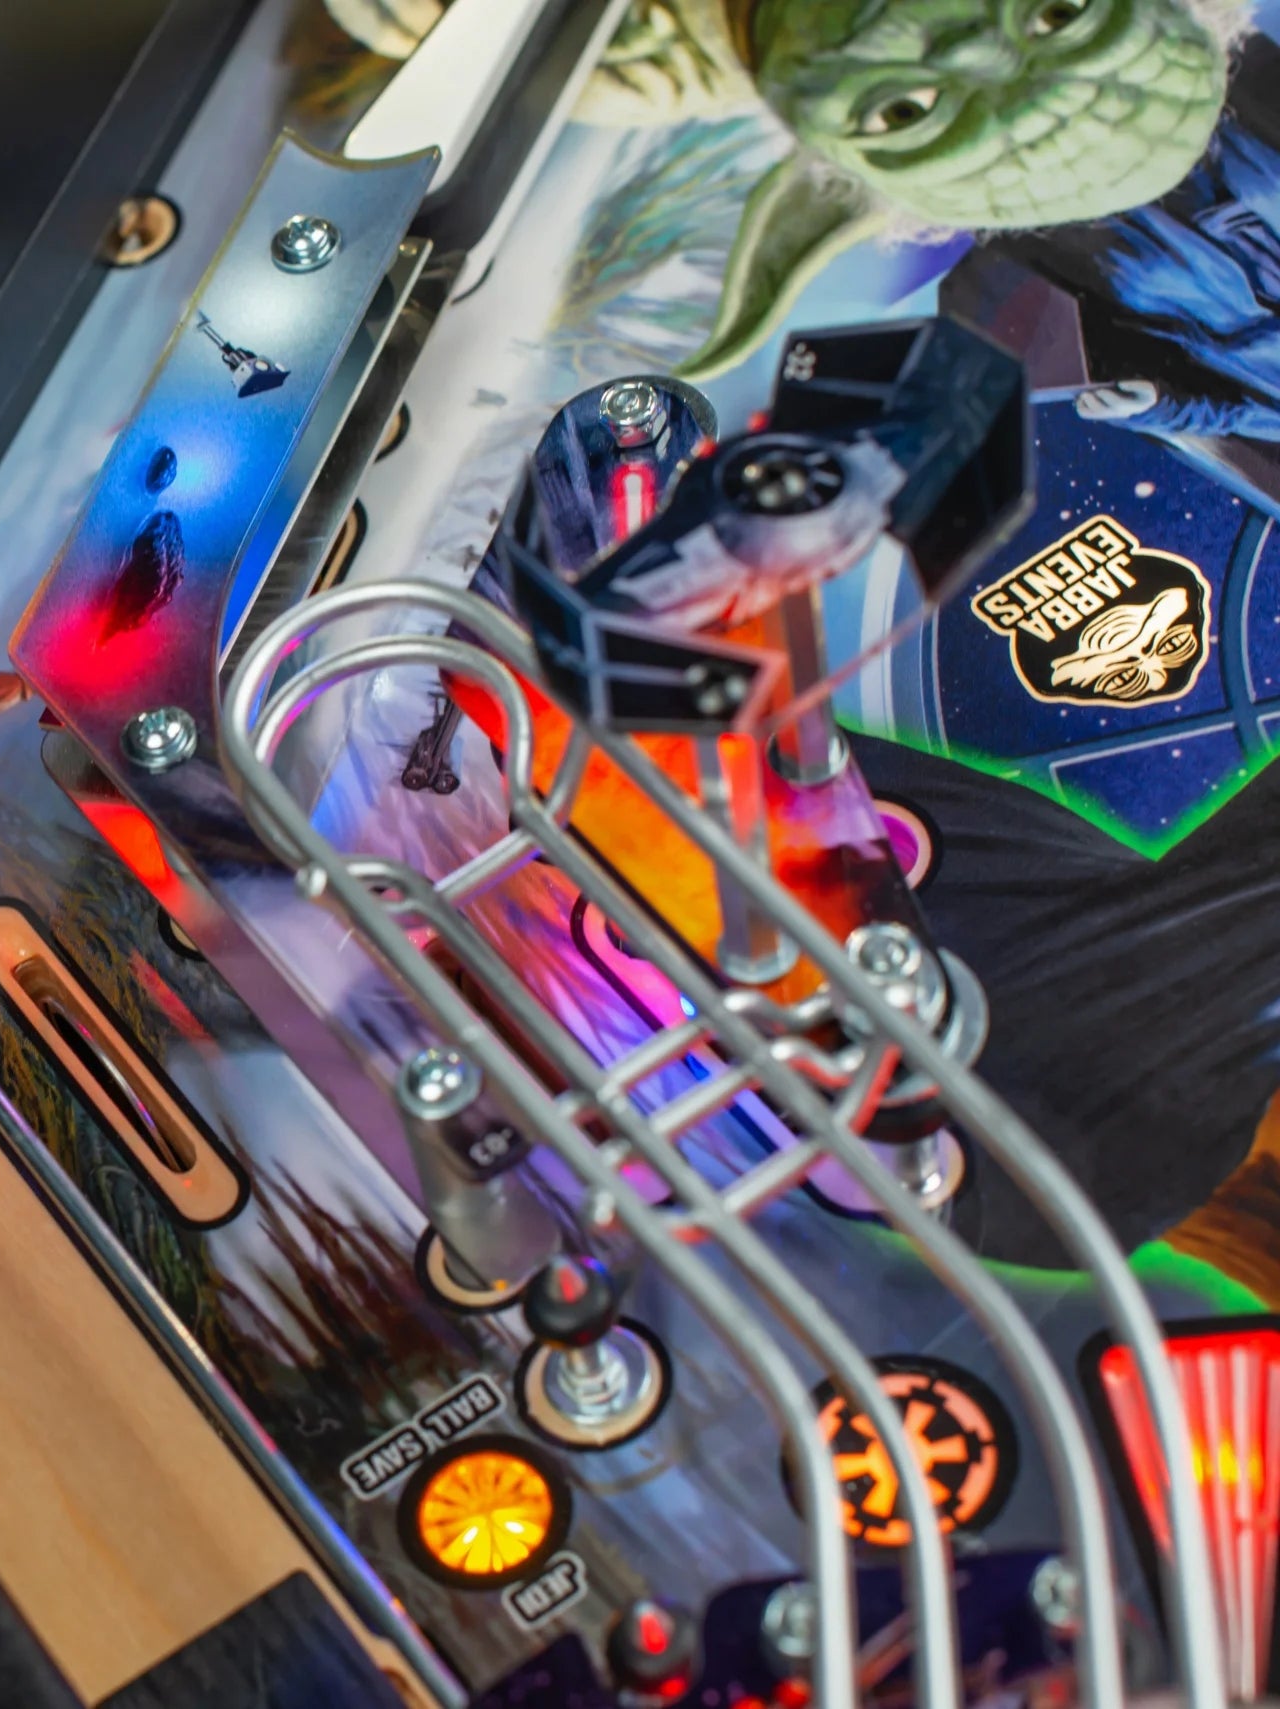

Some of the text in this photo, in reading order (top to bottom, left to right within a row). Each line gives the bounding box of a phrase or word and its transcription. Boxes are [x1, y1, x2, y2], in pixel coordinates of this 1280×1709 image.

[984, 524, 1126, 627] EVENTS
[1017, 553, 1137, 643] JABBA
[352, 1384, 493, 1489] BALL SAVE
[515, 1561, 574, 1617] JEDI
